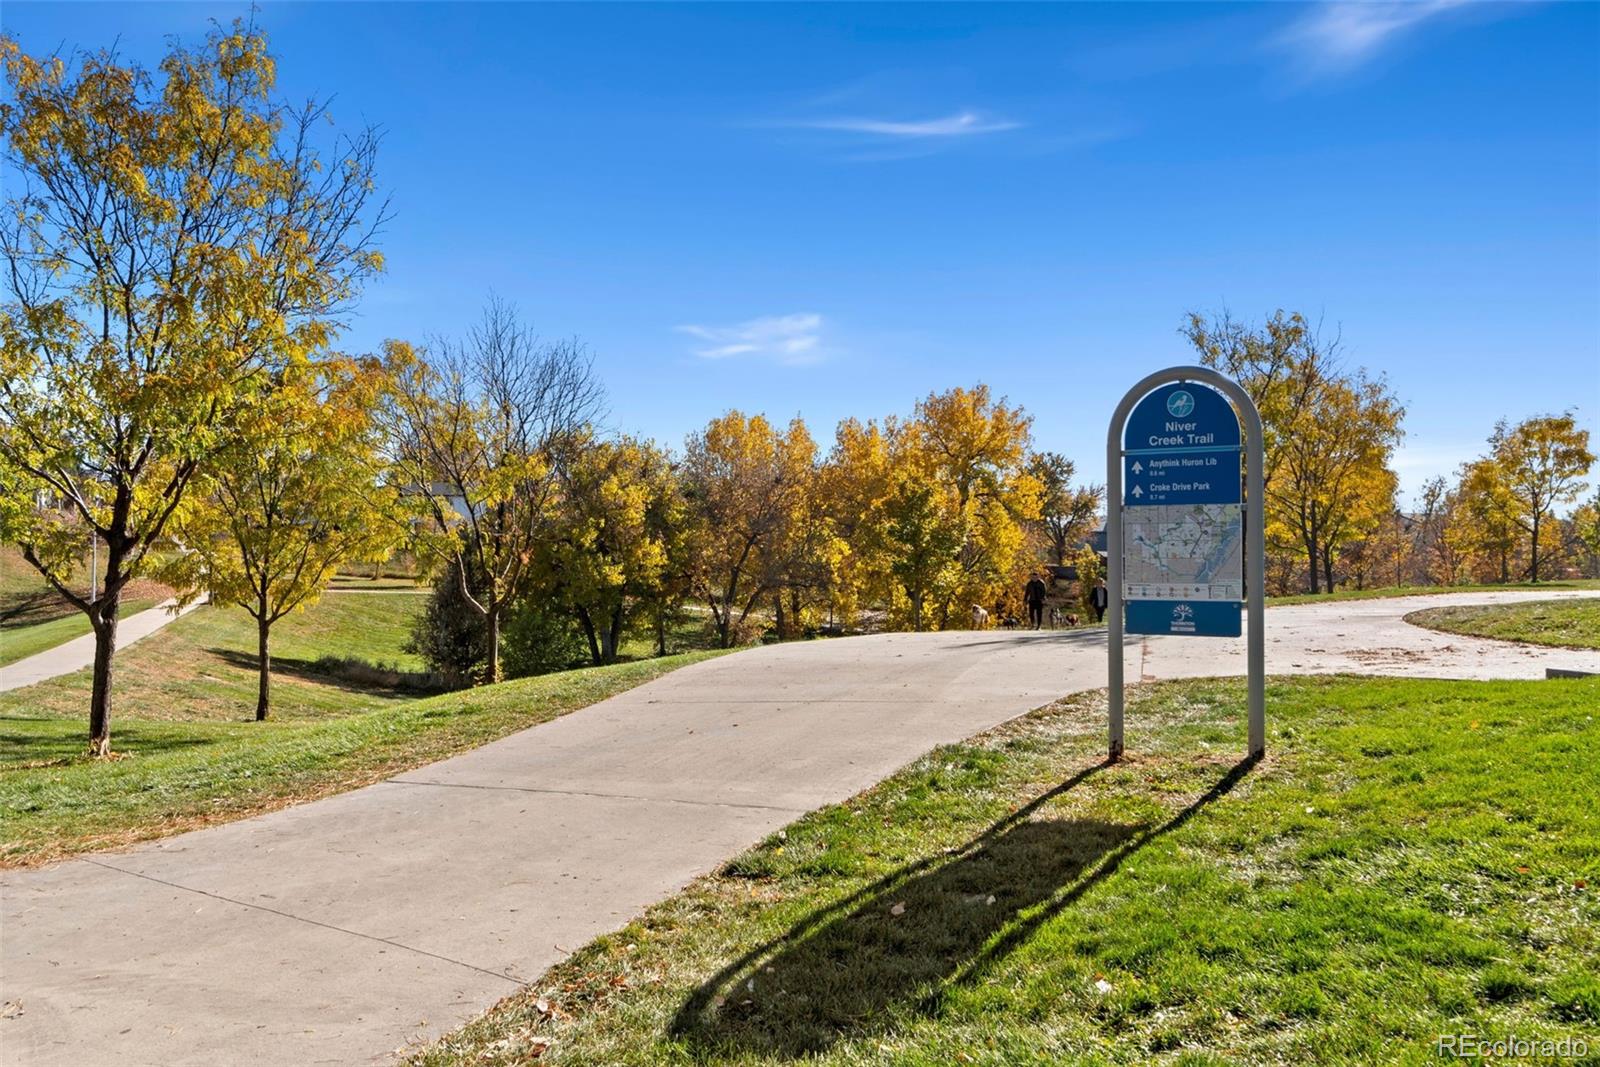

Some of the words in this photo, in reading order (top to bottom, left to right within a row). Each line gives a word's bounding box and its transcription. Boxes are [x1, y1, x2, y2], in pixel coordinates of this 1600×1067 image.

[1165, 421, 1197, 432] Niver
[1148, 435, 1184, 446] Creek
[1187, 433, 1214, 444] Trail
[1149, 459, 1180, 469] Anythink
[1181, 459, 1204, 467] Huron
[1205, 457, 1218, 466] Lib
[1150, 483, 1171, 492] Croke
[1172, 482, 1192, 491] Drive
[1193, 481, 1211, 490] Park
